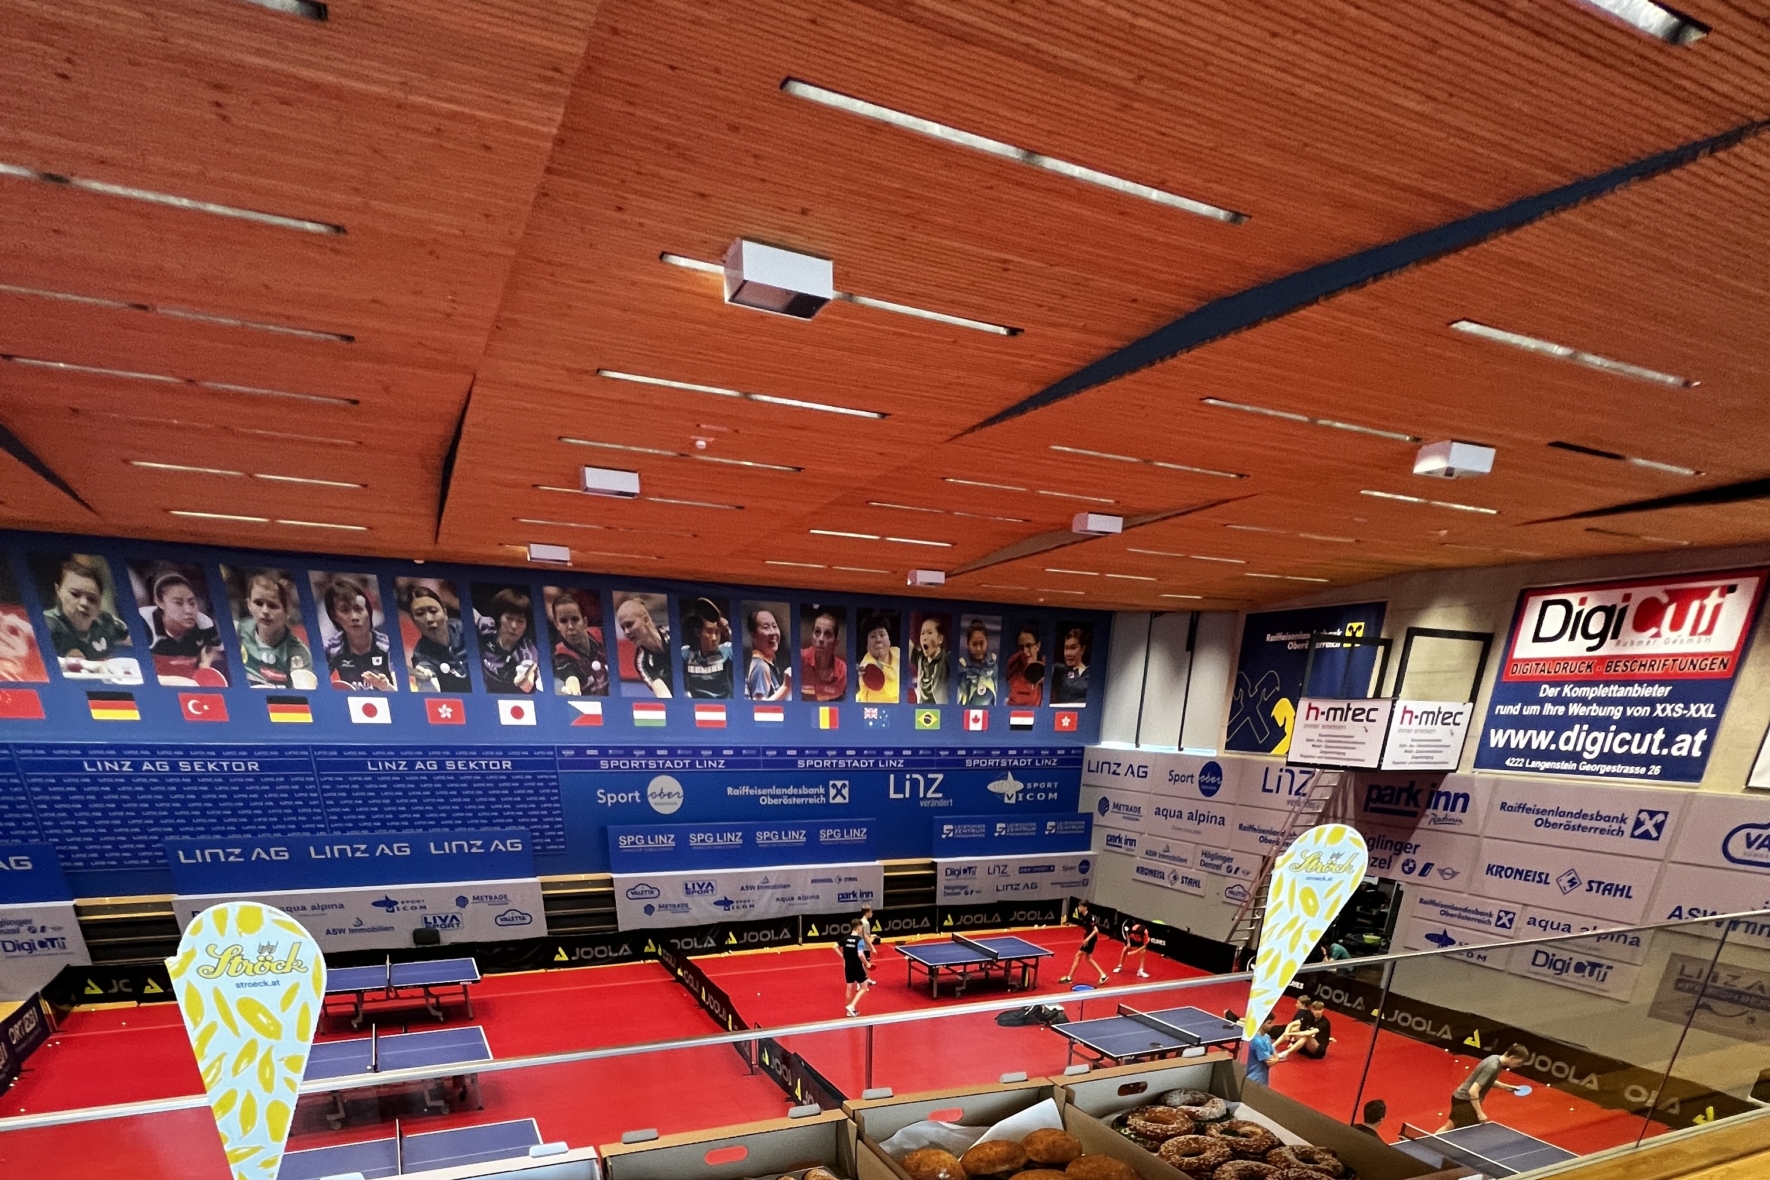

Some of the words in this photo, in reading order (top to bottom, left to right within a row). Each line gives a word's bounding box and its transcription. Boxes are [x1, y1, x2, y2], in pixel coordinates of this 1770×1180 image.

[1511, 660, 1594, 675] DIGITALDRUCK
[1604, 657, 1730, 673] BESCHRIFTUNGEN
[1539, 684, 1560, 698] Der
[1562, 684, 1673, 700] Komplettanbieter
[1495, 703, 1520, 715] rund
[1522, 707, 1540, 716] um
[1542, 703, 1565, 716] Ihre
[1568, 703, 1623, 719] Werbung
[1626, 707, 1650, 717] von
[1653, 703, 1717, 718] XXS-XXL
[1489, 724, 1707, 759] www.digicut.at
[84, 761, 133, 772] LINZ
[142, 761, 170, 772] AG
[179, 760, 260, 772] SEKTOR
[367, 760, 408, 771] LINZ
[415, 760, 438, 770] AG
[445, 760, 513, 770] SEKTOR
[600, 760, 691, 769] SPORTSTADT
[695, 759, 726, 769] LINZ
[797, 759, 876, 768] SPORTSTADT
[879, 759, 905, 768] LINZ
[965, 758, 1032, 767] SPORTSTADT
[1035, 758, 1058, 766] LINZ
[1505, 757, 1524, 767] 4222
[1526, 758, 1577, 771] Langenstein
[1579, 761, 1646, 776] Georgestrasse
[1649, 765, 1661, 775] 26
[1124, 763, 1148, 779] AG
[1168, 769, 1194, 785] Sport
[727, 785, 825, 797] Raiffeisenlandesbank
[1363, 781, 1423, 812] park
[1425, 782, 1470, 813] inn
[597, 789, 641, 807] Sport
[759, 795, 826, 806] Oberösterreich
[1112, 802, 1142, 814] METRADE
[1500, 801, 1628, 825] Raiffeisenlandesbank
[1154, 806, 1183, 821] aqua
[1187, 809, 1226, 826] alpina
[819, 829, 841, 839] SPG
[843, 828, 867, 838] LINZ
[1534, 817, 1624, 838] Oberösterreich
[619, 834, 645, 845] SPG
[648, 834, 675, 844] LINZ
[689, 833, 714, 843] SPG
[716, 832, 743, 842] LINZ
[756, 831, 778, 841] SPG
[782, 830, 806, 840] LINZ
[1106, 833, 1123, 846] park
[1124, 835, 1136, 847] inn
[375, 843, 411, 856] AG
[490, 839, 523, 852] AG
[1366, 832, 1421, 855] glinger
[251, 847, 290, 860] AG
[1201, 850, 1234, 864] Höglinger
[1200, 859, 1223, 871] Denzel
[1289, 849, 1359, 875] Ströck
[684, 881, 715, 890] LIVA
[1022, 882, 1038, 890] AG
[1180, 875, 1202, 888] STAHL
[1486, 863, 1551, 885] KRONEISL
[1585, 879, 1633, 899] STAHL
[472, 894, 509, 902] METRADE
[837, 890, 858, 899] park
[859, 889, 874, 898] inn
[279, 905, 307, 914] aqua
[310, 903, 345, 912] alpina
[1419, 897, 1494, 918] Raiffeisenlandesbank
[423, 915, 461, 925] LIVA
[956, 913, 1001, 926] JOOLA
[1009, 910, 1055, 921] JOOLA
[1439, 909, 1492, 926] Oberösterreich
[821, 923, 851, 936] JOO
[884, 917, 931, 931] JOOLA
[1526, 916, 1572, 933] aqua
[325, 927, 346, 936] ASW
[739, 928, 792, 943] JOOLA
[572, 944, 633, 960] JOOLA
[196, 941, 308, 979] Ströck
[235, 979, 281, 988] stroeck.at
[1314, 984, 1365, 1011] JOOLA
[1388, 1009, 1453, 1040] JOOLA
[1522, 1052, 1599, 1091] JOOLA
